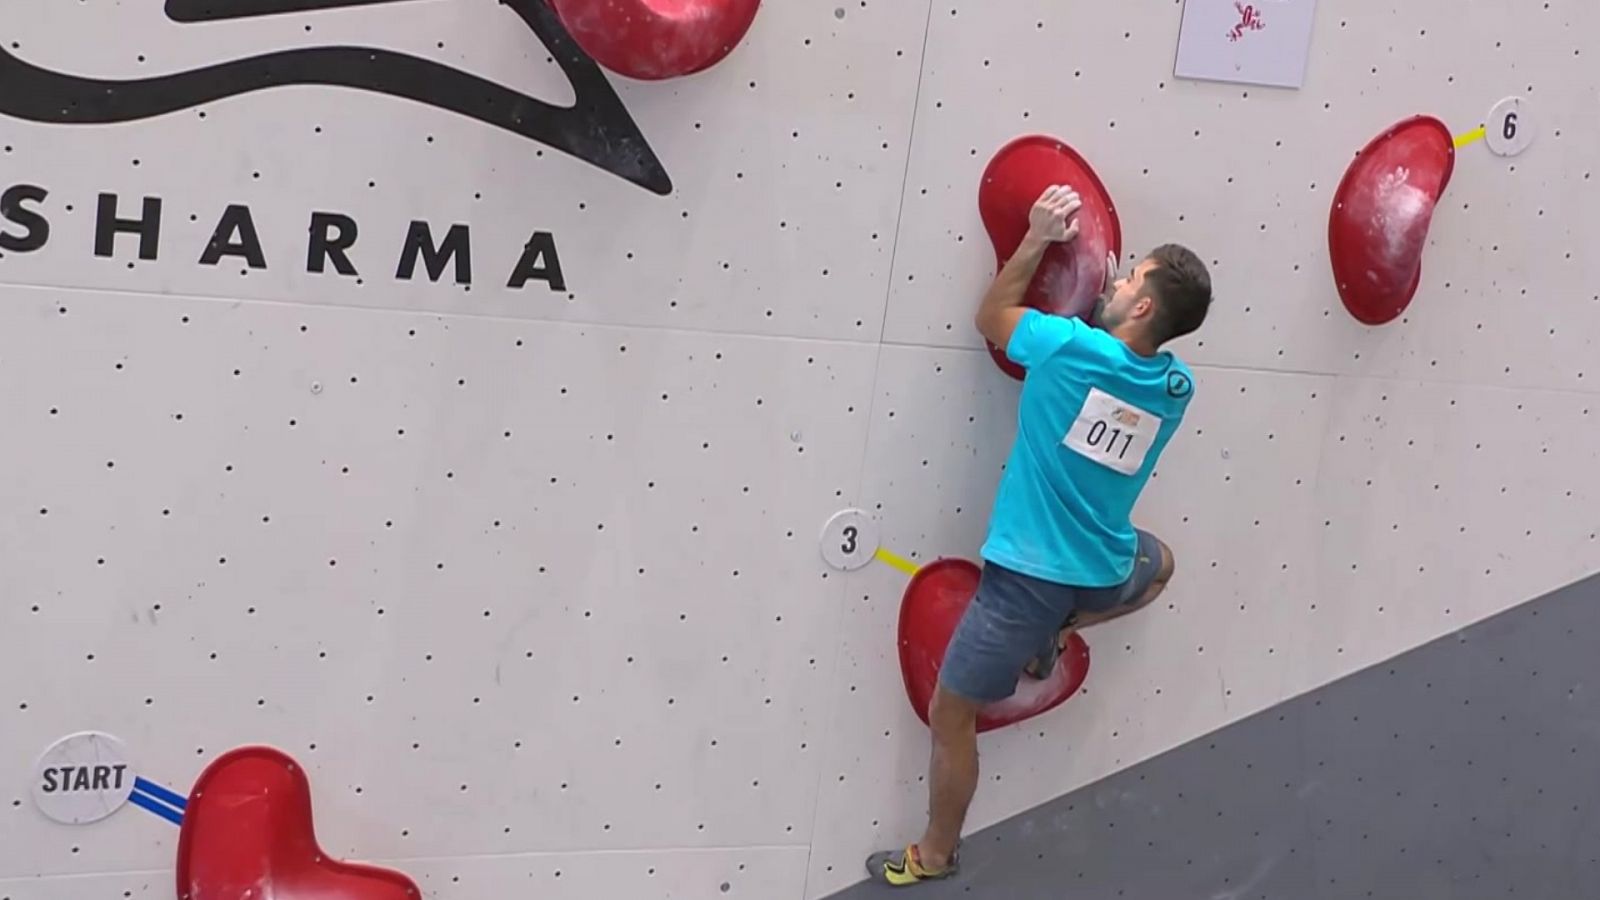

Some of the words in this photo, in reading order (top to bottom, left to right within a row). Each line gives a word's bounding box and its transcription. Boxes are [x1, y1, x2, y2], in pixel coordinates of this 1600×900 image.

[1503, 112, 1518, 140] 6
[0, 184, 567, 292] SHARMA
[1086, 420, 1134, 460] 011
[841, 525, 858, 555] 3
[42, 764, 127, 793] START
